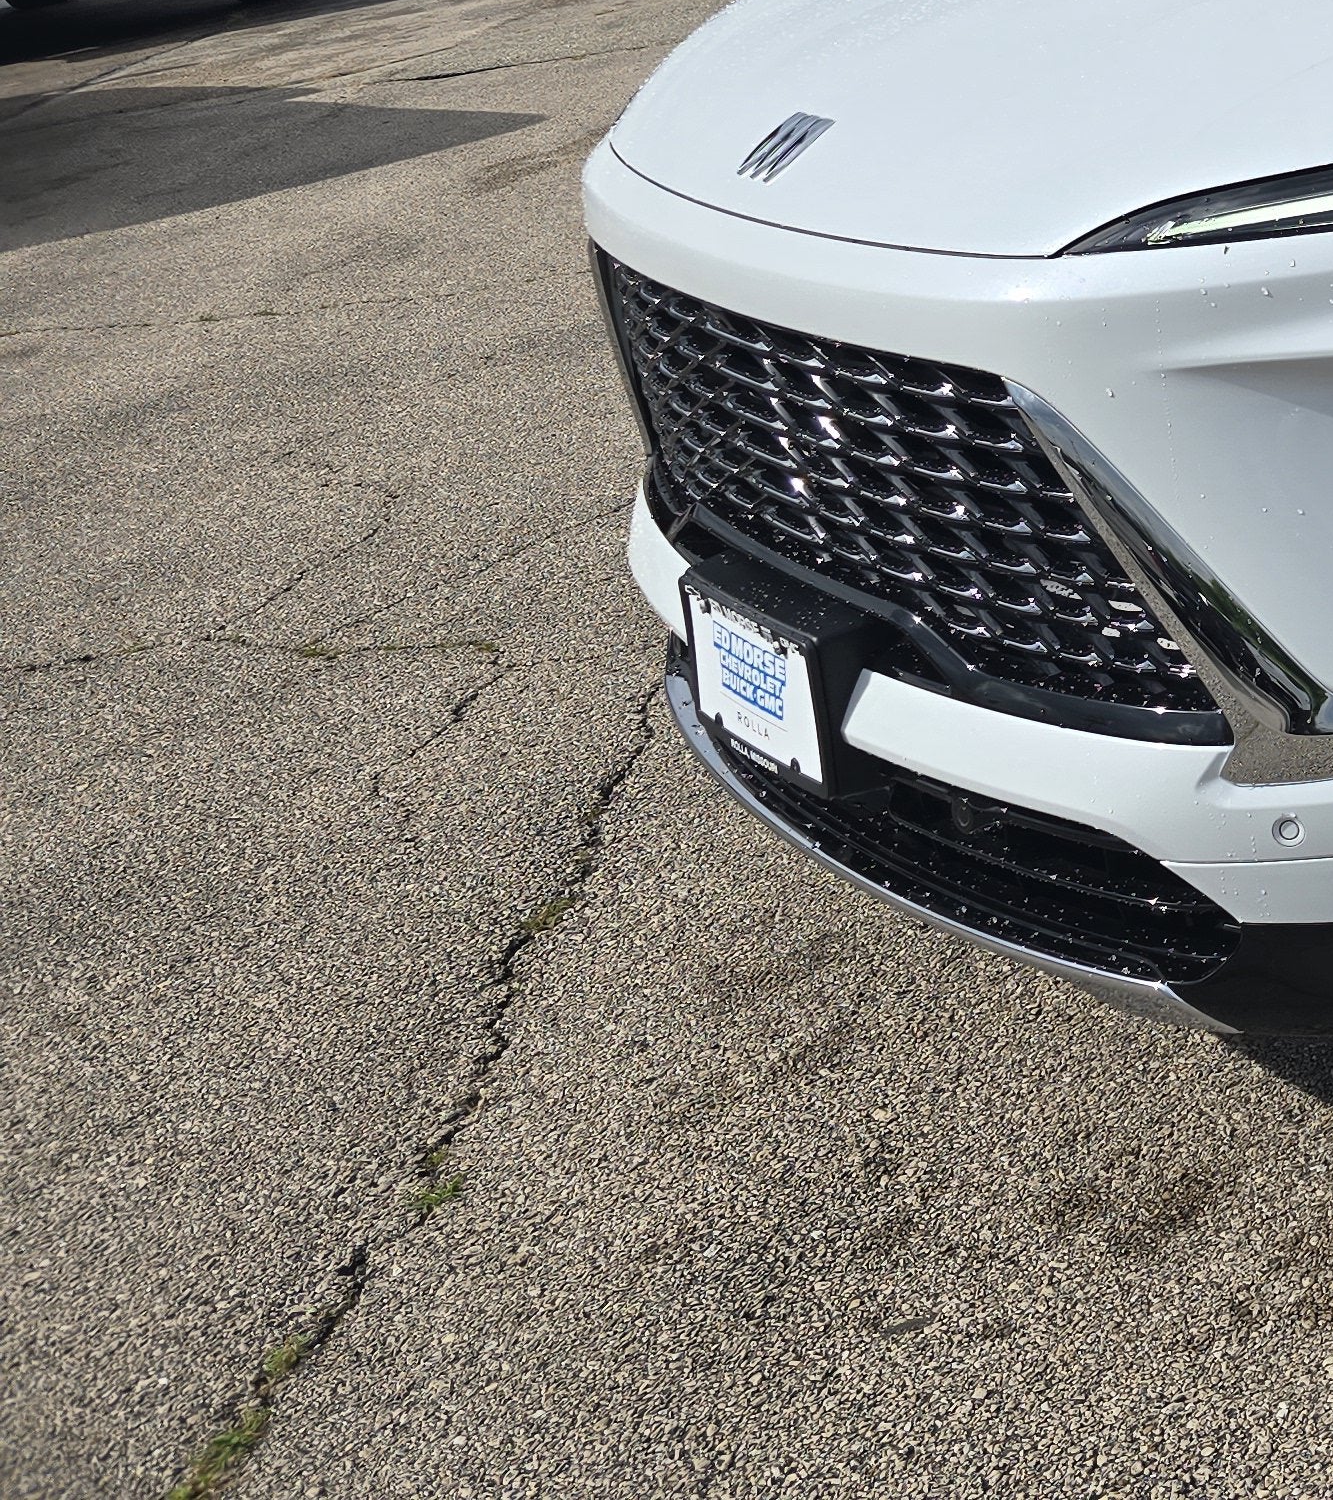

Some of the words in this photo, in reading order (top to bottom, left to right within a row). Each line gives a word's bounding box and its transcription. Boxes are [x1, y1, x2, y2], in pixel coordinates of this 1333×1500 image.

[713, 620, 731, 651] ED
[731, 632, 786, 682] MORSE
[736, 711, 770, 740] ROLLA
